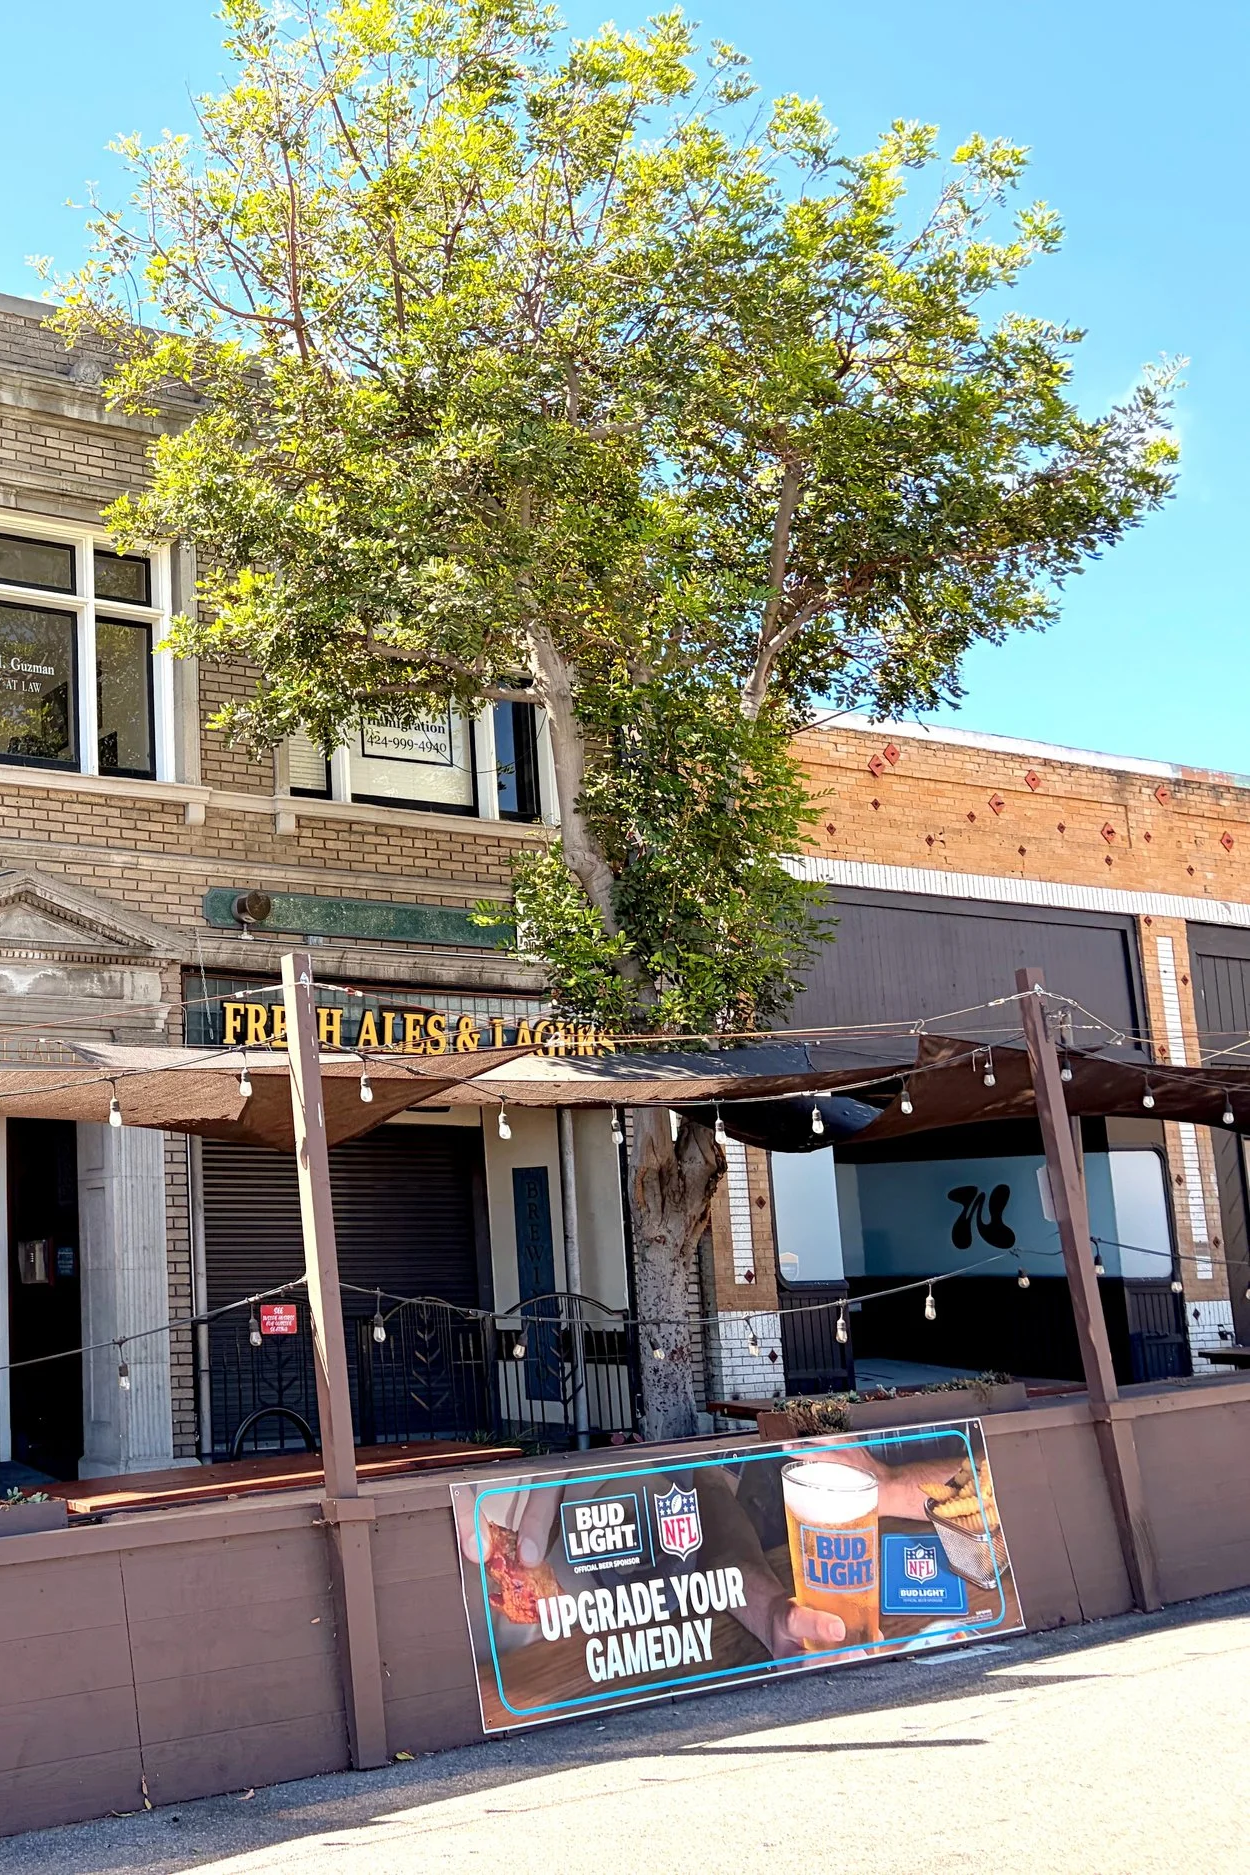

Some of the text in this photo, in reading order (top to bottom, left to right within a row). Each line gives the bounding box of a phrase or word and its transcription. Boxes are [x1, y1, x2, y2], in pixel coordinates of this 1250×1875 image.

[11, 657, 55, 675] Guzman
[6, 679, 18, 690] AT
[22, 681, 42, 693] LAW
[367, 735, 446, 754] 424-999-4940
[223, 1002, 343, 1049] FREH
[358, 1011, 446, 1056] ALES
[456, 1015, 480, 1052] &
[526, 1181, 546, 1298] BREWI
[575, 1502, 625, 1531] BUD
[663, 1516, 697, 1549] NFL
[816, 1535, 866, 1560] BUD
[574, 1557, 640, 1574] OFFICIAL BEER SPONSOR
[909, 1560, 933, 1577] NFL
[537, 1566, 748, 1641] UPGRADE YOUR
[900, 1589, 945, 1597] BUD LIGHT
[586, 1618, 713, 1683] GAMEDAY
